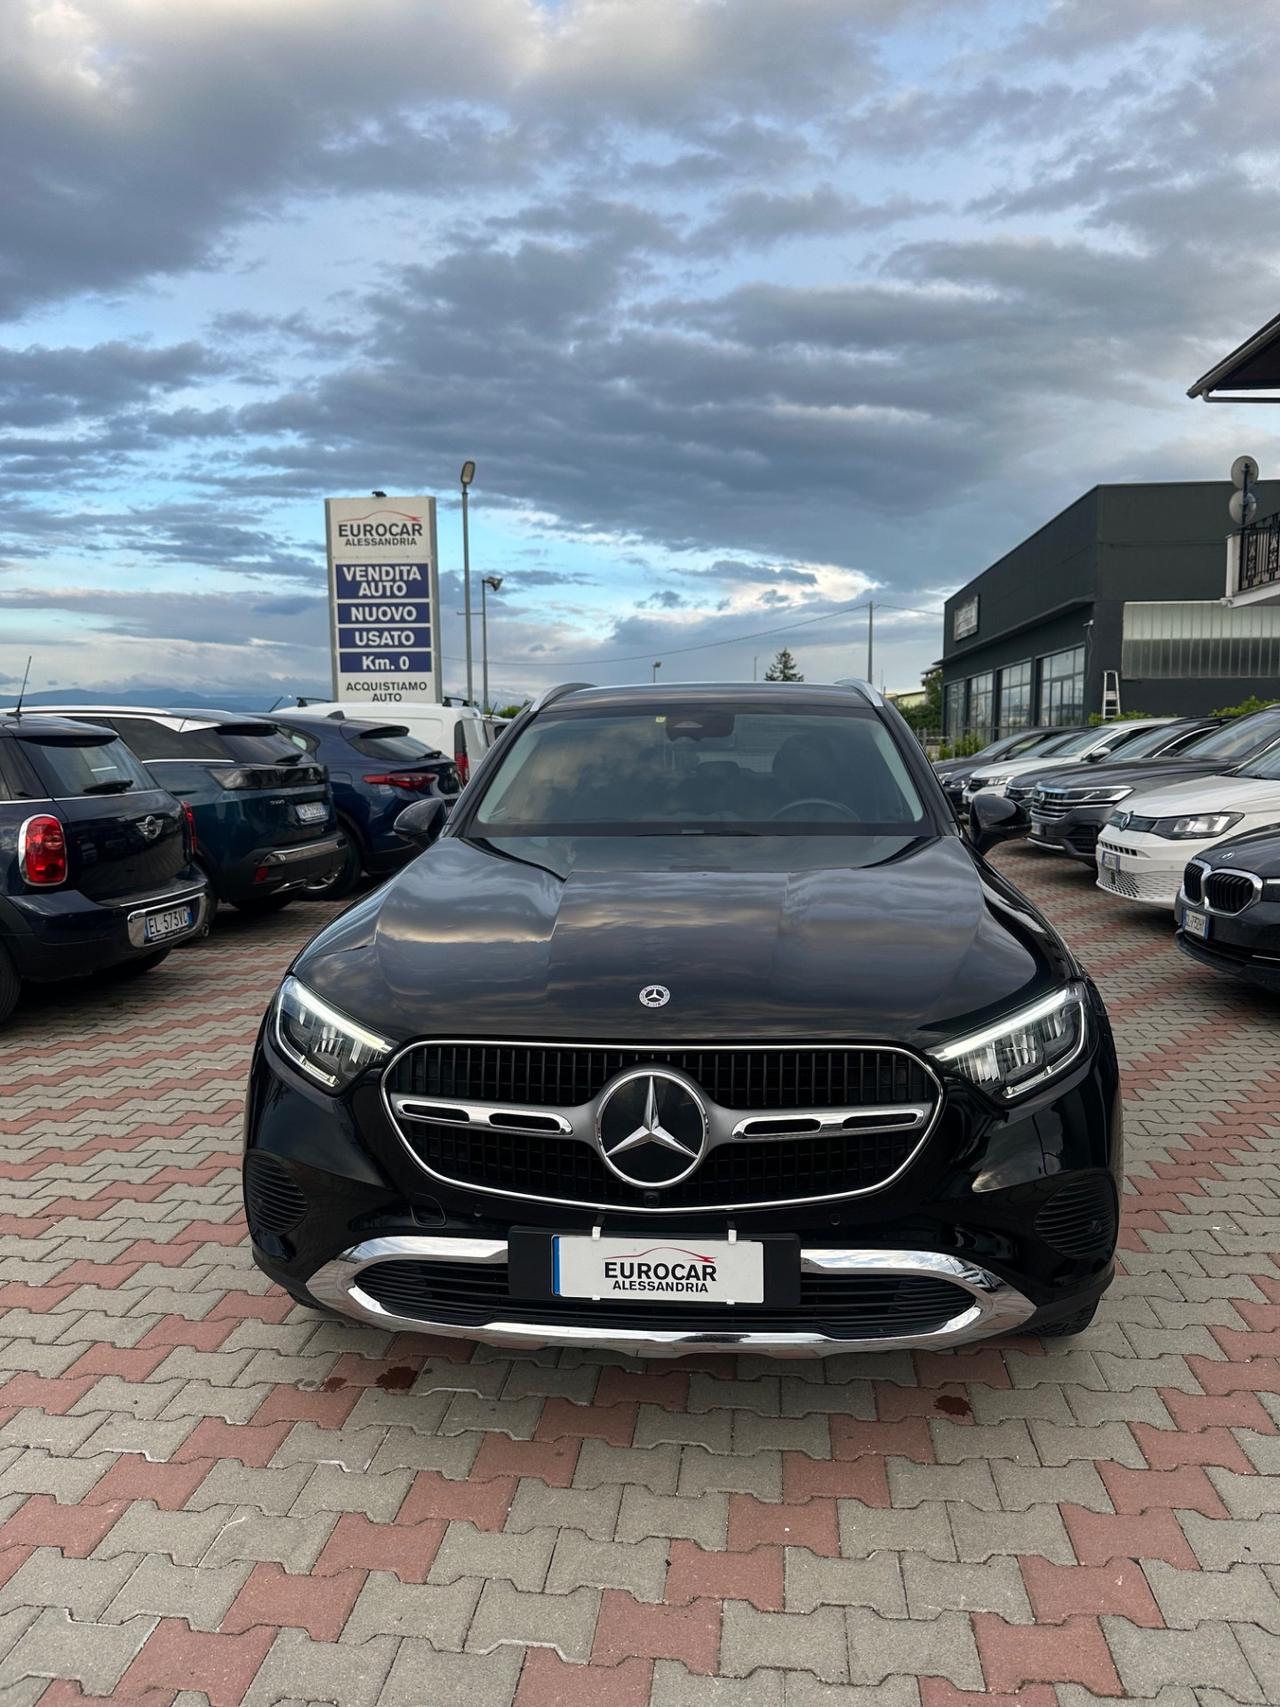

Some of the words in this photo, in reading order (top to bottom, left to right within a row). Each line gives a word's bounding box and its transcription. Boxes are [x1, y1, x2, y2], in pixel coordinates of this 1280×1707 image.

[338, 523, 423, 538] EUROCAR
[345, 537, 417, 547] ALESSANDRIA
[342, 566, 421, 581] VENDITA
[358, 581, 407, 597] AUTO
[351, 606, 417, 621] NUOVO
[354, 630, 415, 646] USATO
[362, 656, 395, 670] Km.
[399, 656, 410, 670] 0
[346, 681, 427, 692] ACQUISTIAMO
[372, 692, 402, 702] AUTO
[148, 917, 161, 936] EL
[604, 1261, 717, 1282] EUROCAR
[612, 1280, 709, 1293] ALESSANDRIA
